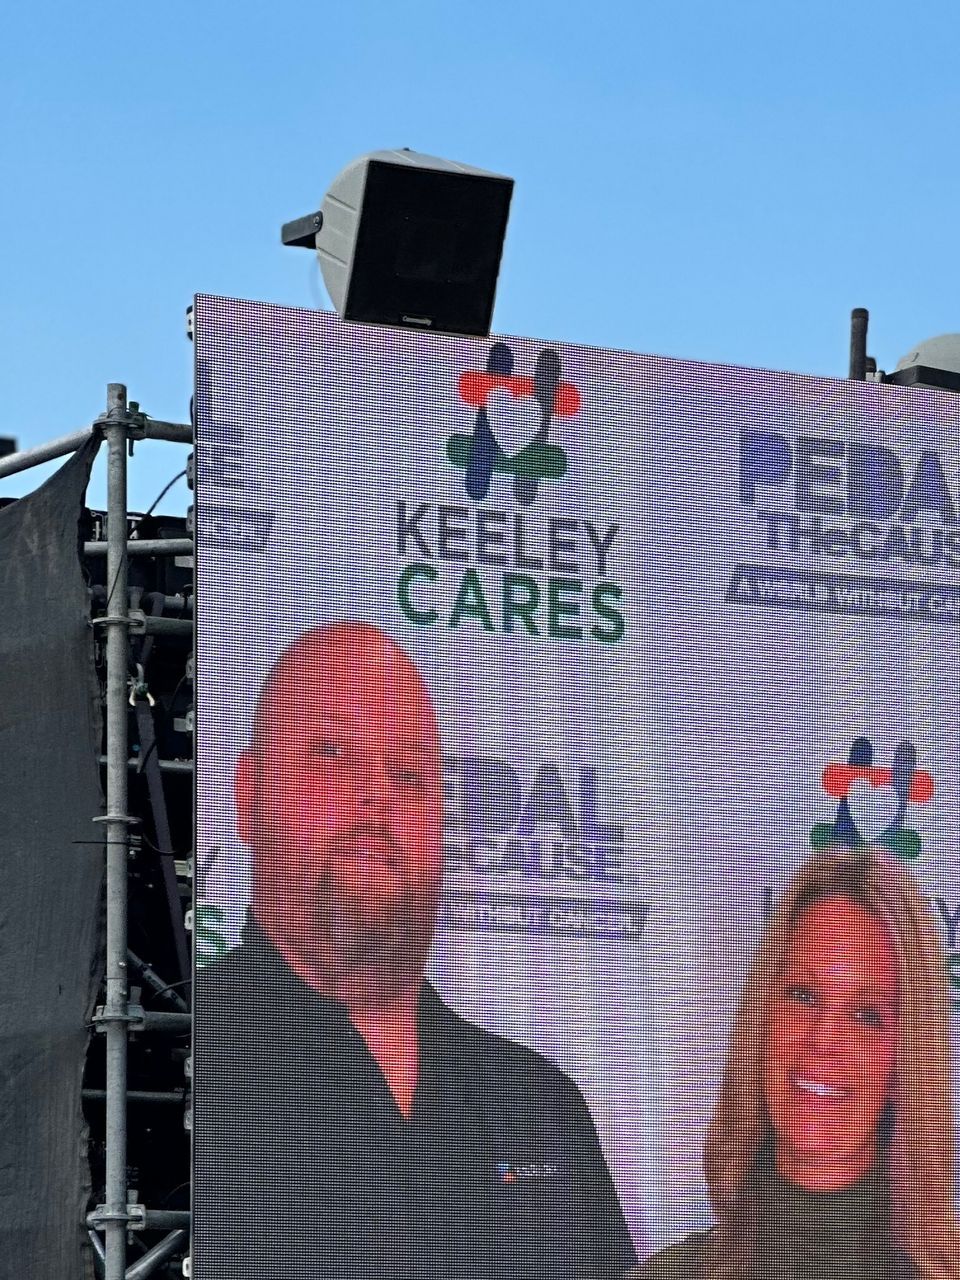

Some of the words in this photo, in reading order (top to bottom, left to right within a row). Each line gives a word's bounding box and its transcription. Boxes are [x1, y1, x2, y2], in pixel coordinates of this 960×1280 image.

[397, 501, 619, 577] KEELEY
[397, 563, 625, 643] CARES
[737, 576, 752, 596] A
[757, 580, 829, 603] WORLD
[836, 586, 921, 611] WITHOUT
